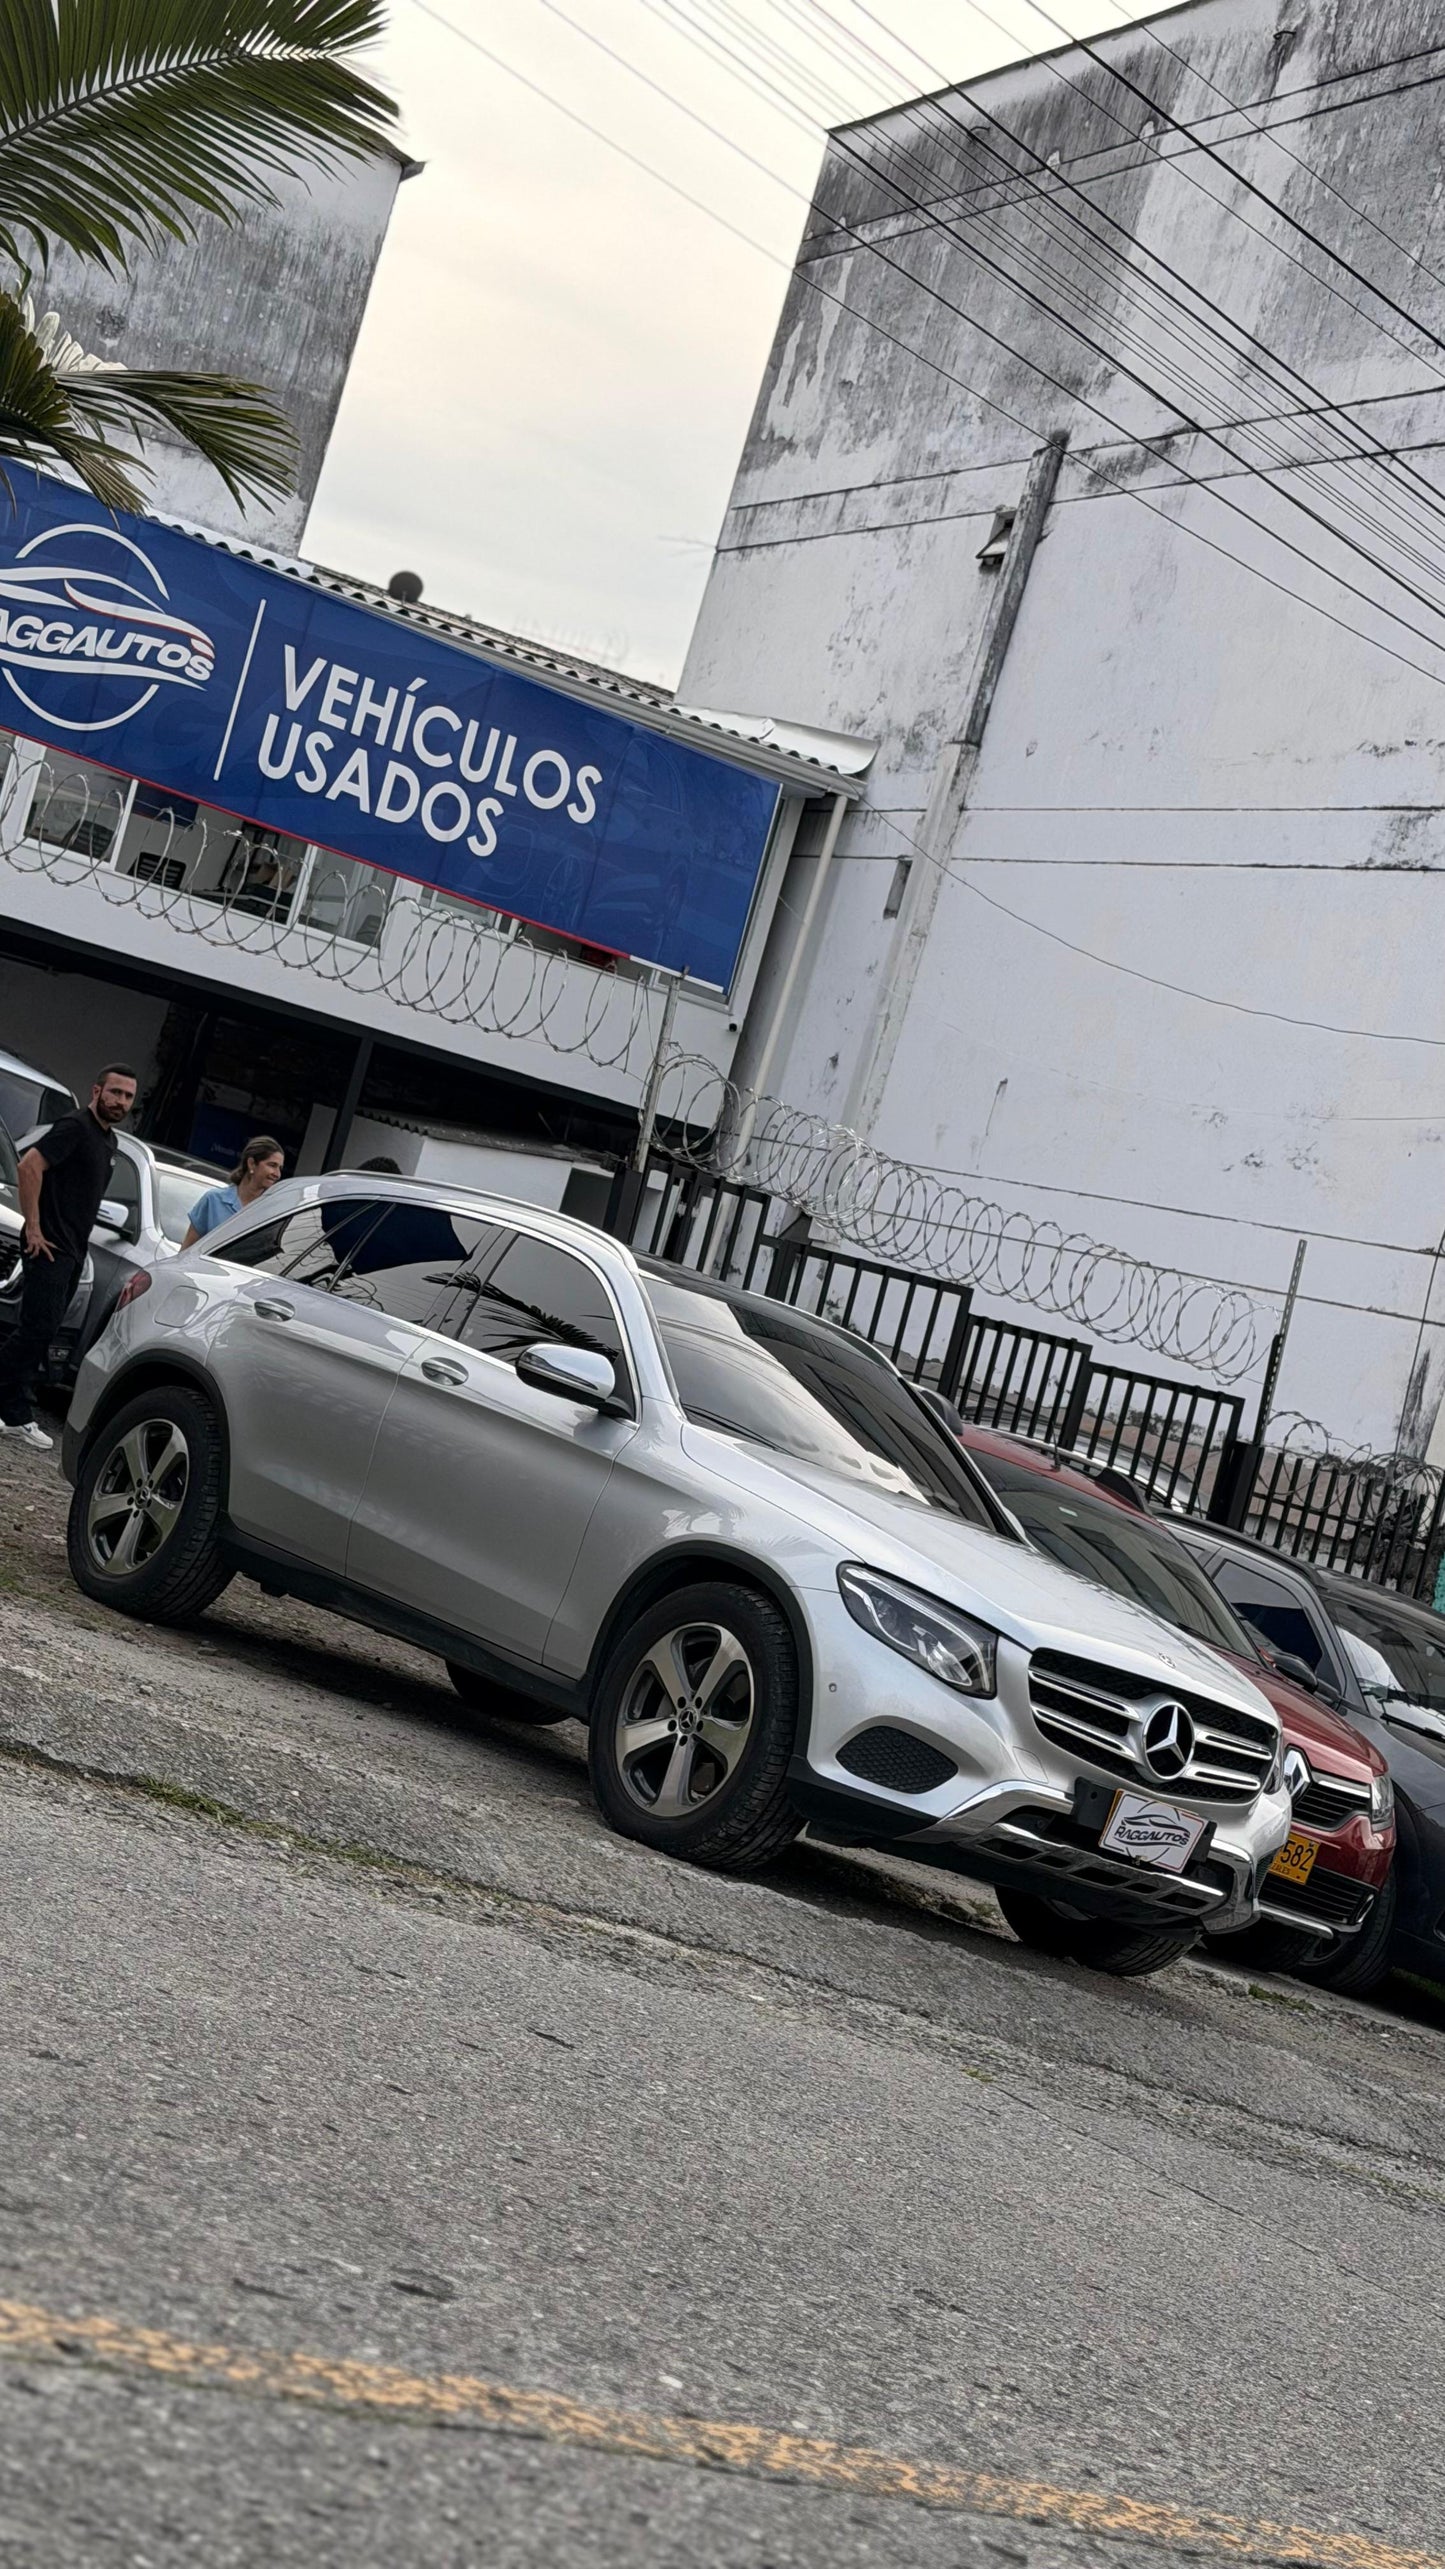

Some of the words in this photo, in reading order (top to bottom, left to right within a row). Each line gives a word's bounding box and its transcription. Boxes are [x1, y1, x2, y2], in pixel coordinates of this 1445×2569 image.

[284, 643, 603, 824] VEHÍCULOS
[258, 713, 504, 857] USADOS
[1114, 1826, 1189, 1846] RAGGAUTOS
[1280, 1840, 1314, 1872] 582
